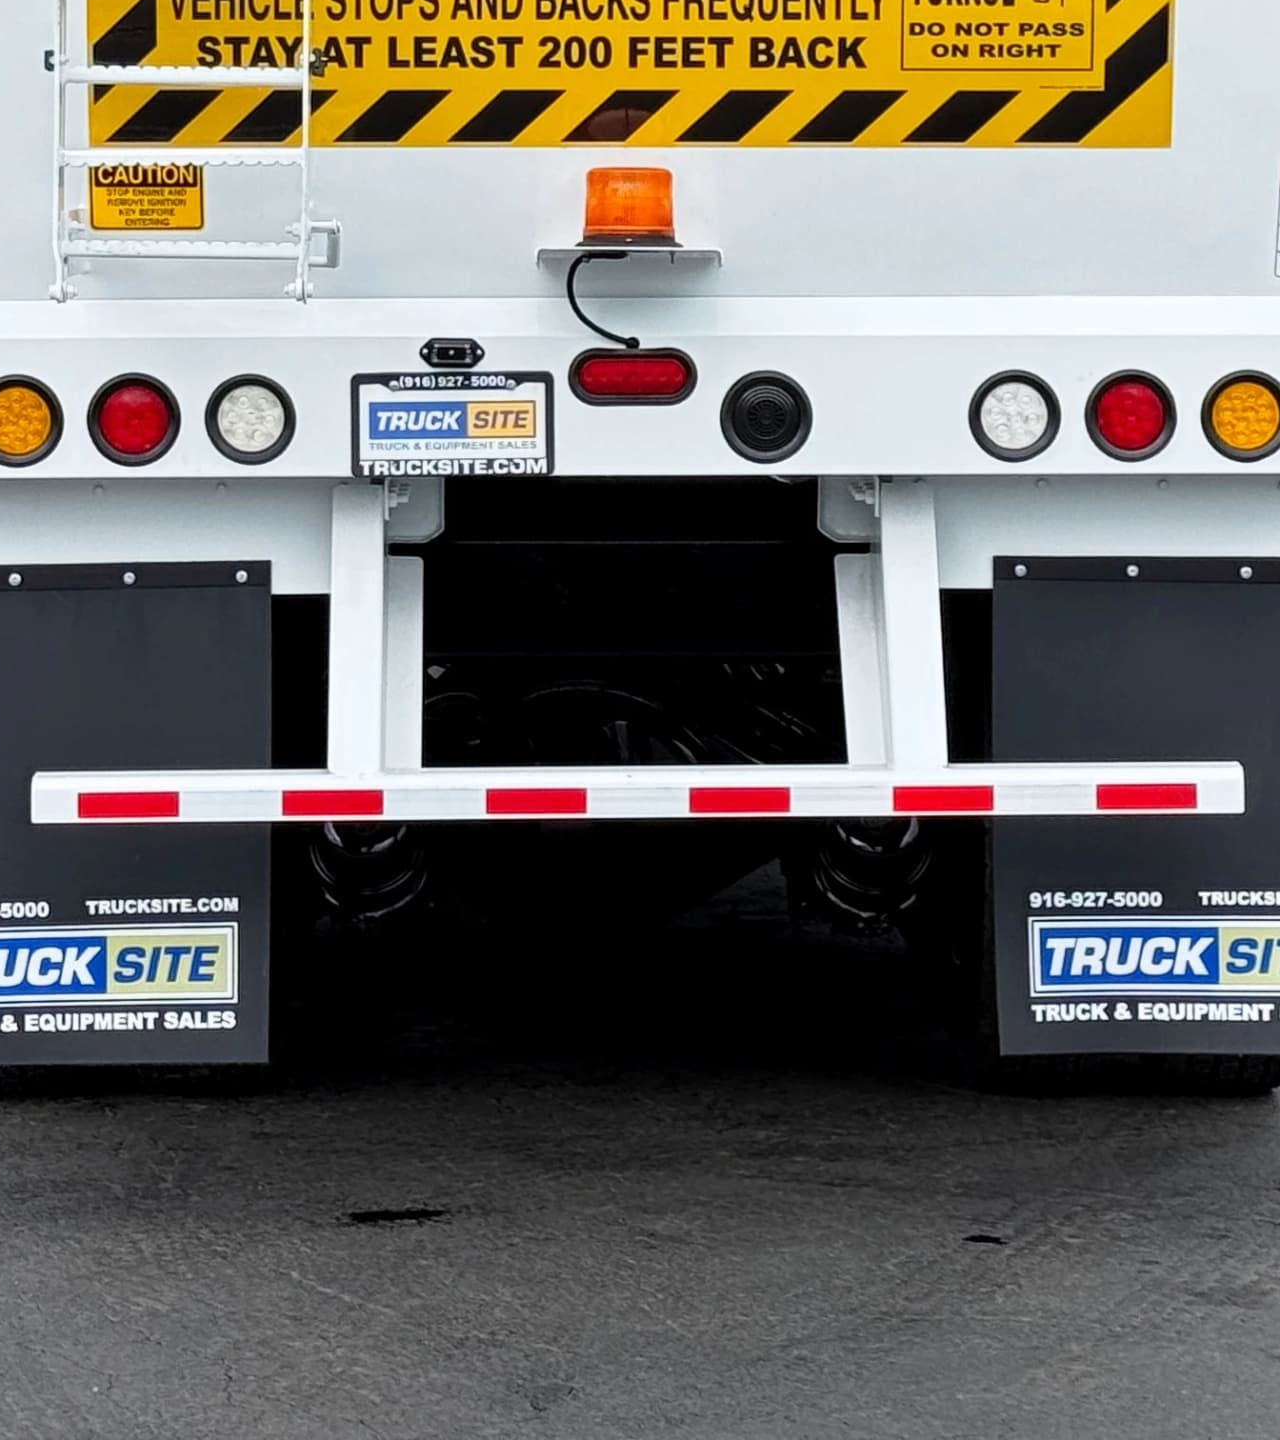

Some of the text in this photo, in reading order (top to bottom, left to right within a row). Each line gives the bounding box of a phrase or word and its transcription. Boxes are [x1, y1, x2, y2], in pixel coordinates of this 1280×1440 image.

[909, 22, 1084, 36] DO NOT PASS
[197, 36, 866, 68] STAY AT LEAST 200 FEET BACK
[931, 44, 1061, 58] ON RIGHT
[98, 166, 194, 184] CAUTION
[377, 410, 529, 431] TRUCK SITE
[369, 440, 537, 451] TRUCK & EQUIPMENT SALES
[361, 459, 548, 476] TRUCKSITE.COM
[86, 897, 238, 915] TRUCKSITE.COM
[1029, 892, 1162, 908] 916-927-5000
[113, 945, 219, 983] SITE
[1045, 937, 1214, 976] TRUCK
[0, 1015, 18, 1032] &
[24, 1012, 158, 1032] EQUIPMENT
[163, 1011, 236, 1030] SALES
[1031, 1003, 1108, 1022] TRUCK
[1113, 1004, 1132, 1021] &
[1138, 1003, 1274, 1022] EQUIPMENT
